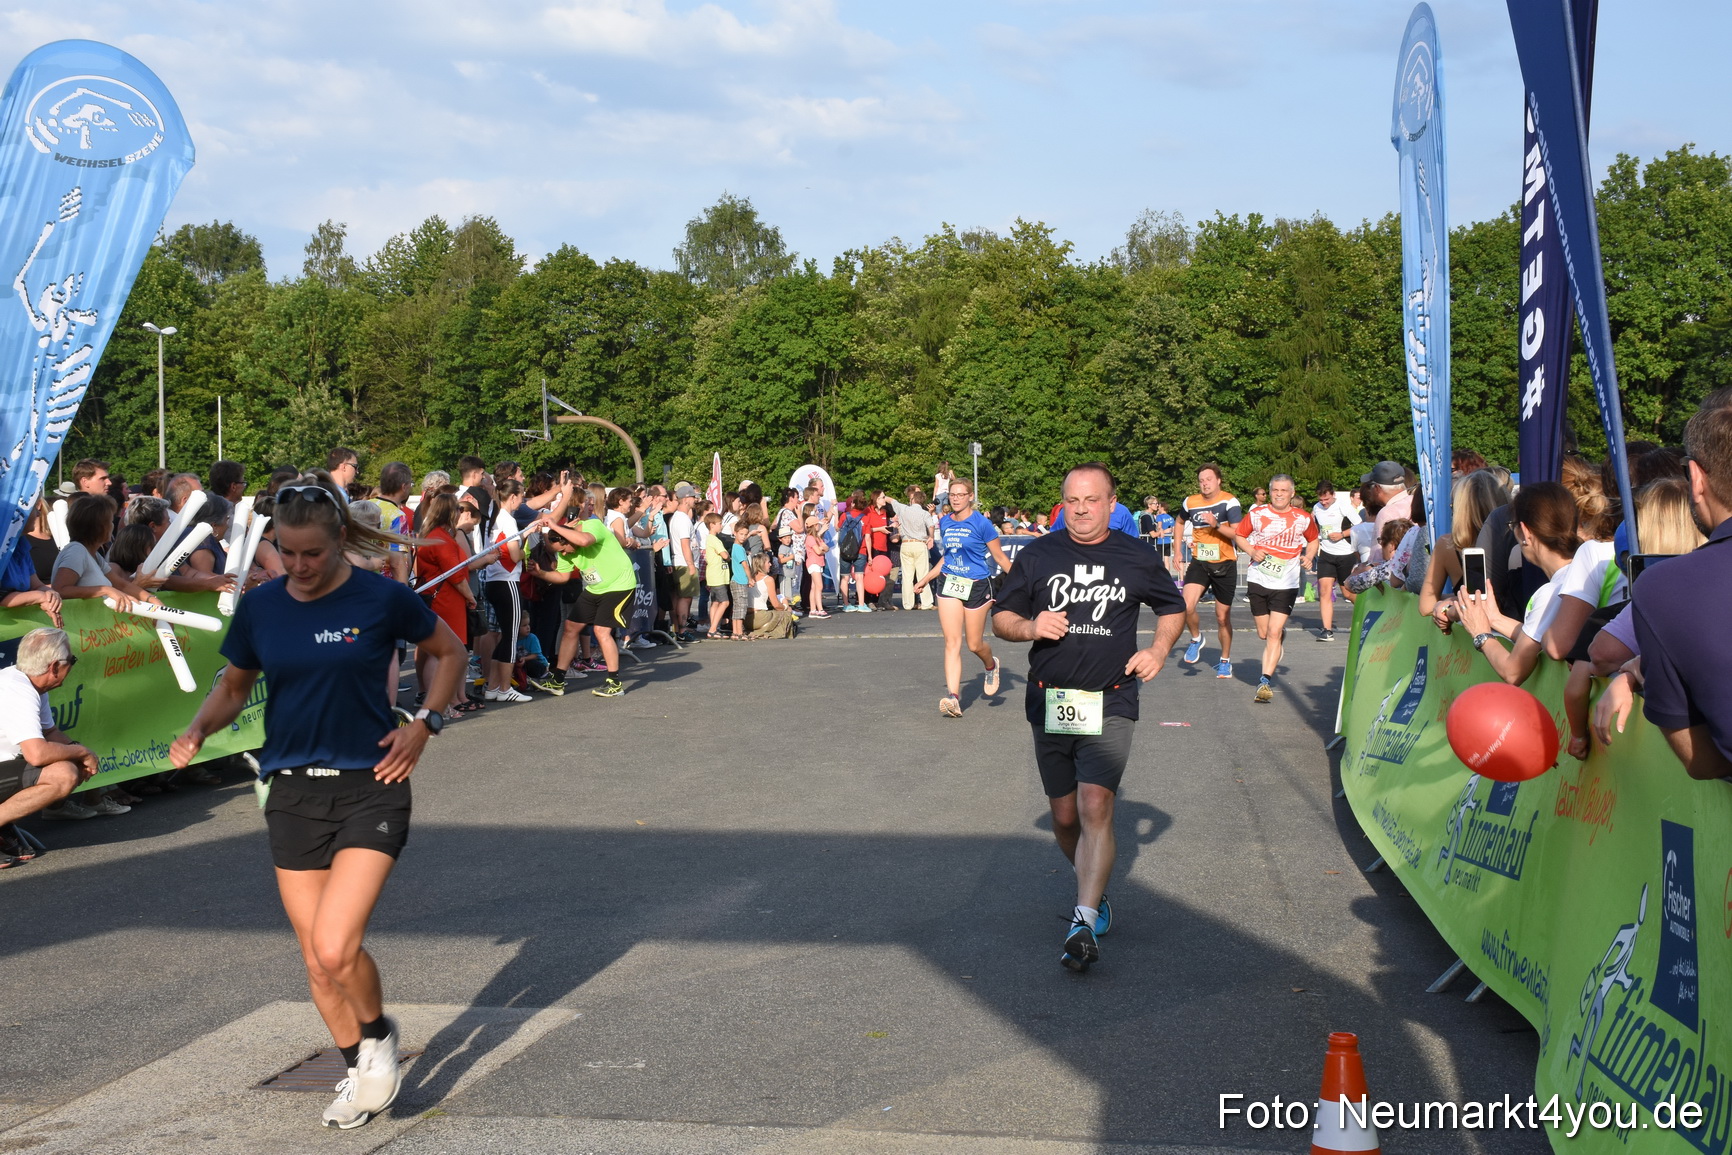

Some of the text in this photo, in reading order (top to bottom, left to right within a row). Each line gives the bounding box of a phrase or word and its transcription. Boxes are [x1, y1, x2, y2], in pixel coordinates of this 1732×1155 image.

[54, 131, 164, 169] WECHSELSZENE
[1200, 549, 1214, 557] 790
[1261, 560, 1282, 574] 2215
[950, 582, 965, 594] 733
[1046, 573, 1126, 622] Burgis
[313, 629, 343, 644] vhs
[1069, 623, 1113, 637] delliebe.
[104, 643, 145, 679] laufen
[1461, 798, 1540, 880] firmenlauf
[1667, 880, 1691, 922] Fischer
[1669, 919, 1691, 943] AUTOMOBILE
